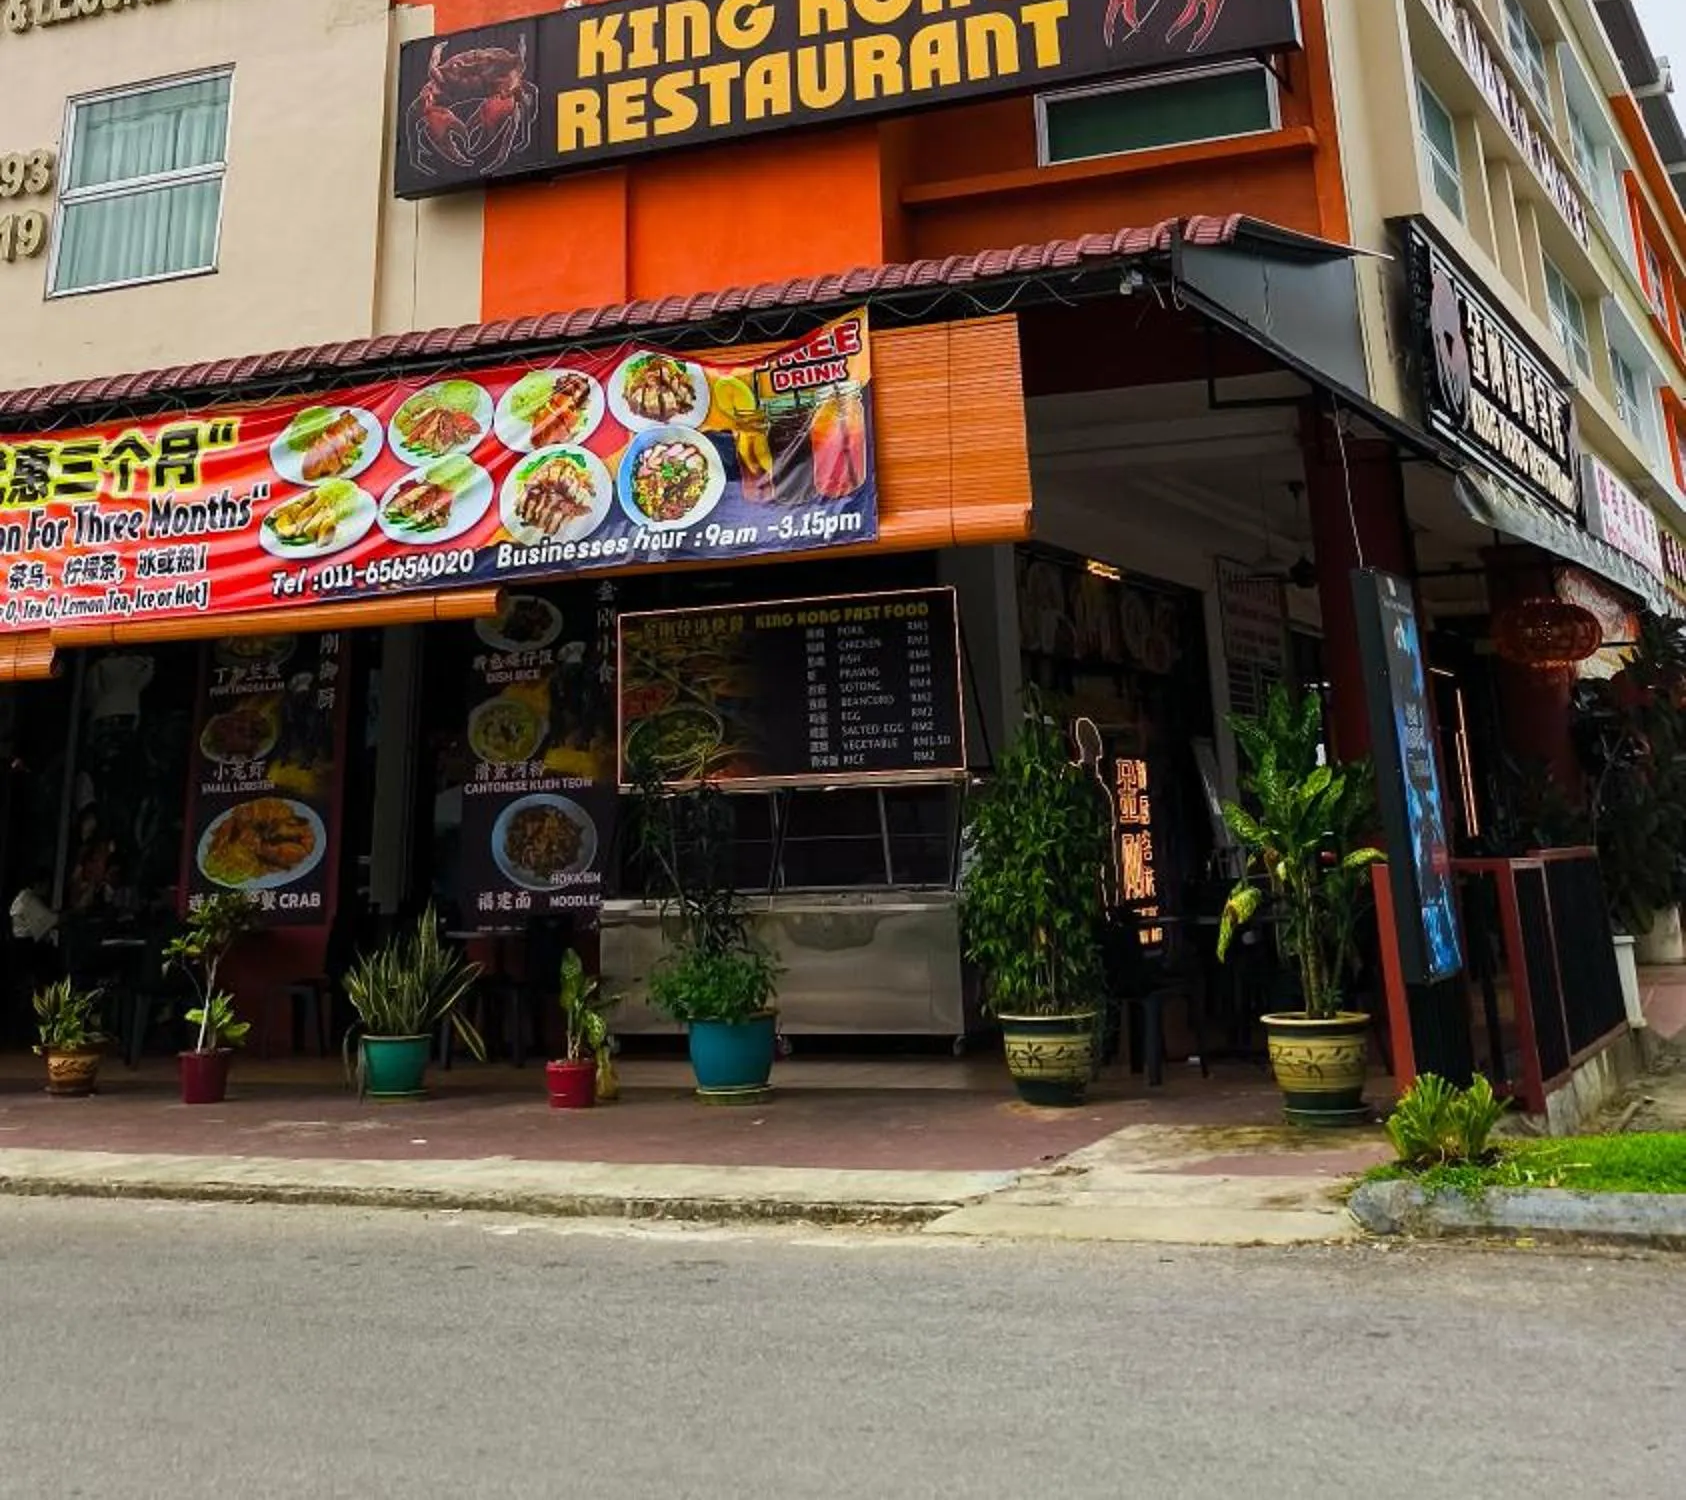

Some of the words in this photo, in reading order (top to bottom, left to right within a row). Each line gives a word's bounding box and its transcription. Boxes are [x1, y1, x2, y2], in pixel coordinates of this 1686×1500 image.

[774, 360, 848, 391] DRINK
[27, 508, 69, 551] For
[74, 504, 144, 546] Three
[272, 568, 306, 596] Tel
[495, 535, 628, 570] Businesses
[629, 523, 688, 553] hour
[62, 596, 104, 617] Lemon
[136, 588, 156, 609] Ice
[157, 591, 173, 607] or
[755, 612, 795, 630] KING
[797, 607, 841, 626] KONG
[884, 602, 929, 620] FOOD
[841, 710, 861, 722] EGG
[464, 781, 529, 796] CANTONESE
[550, 871, 601, 886] HOKKIEN
[280, 892, 322, 909] CRAB
